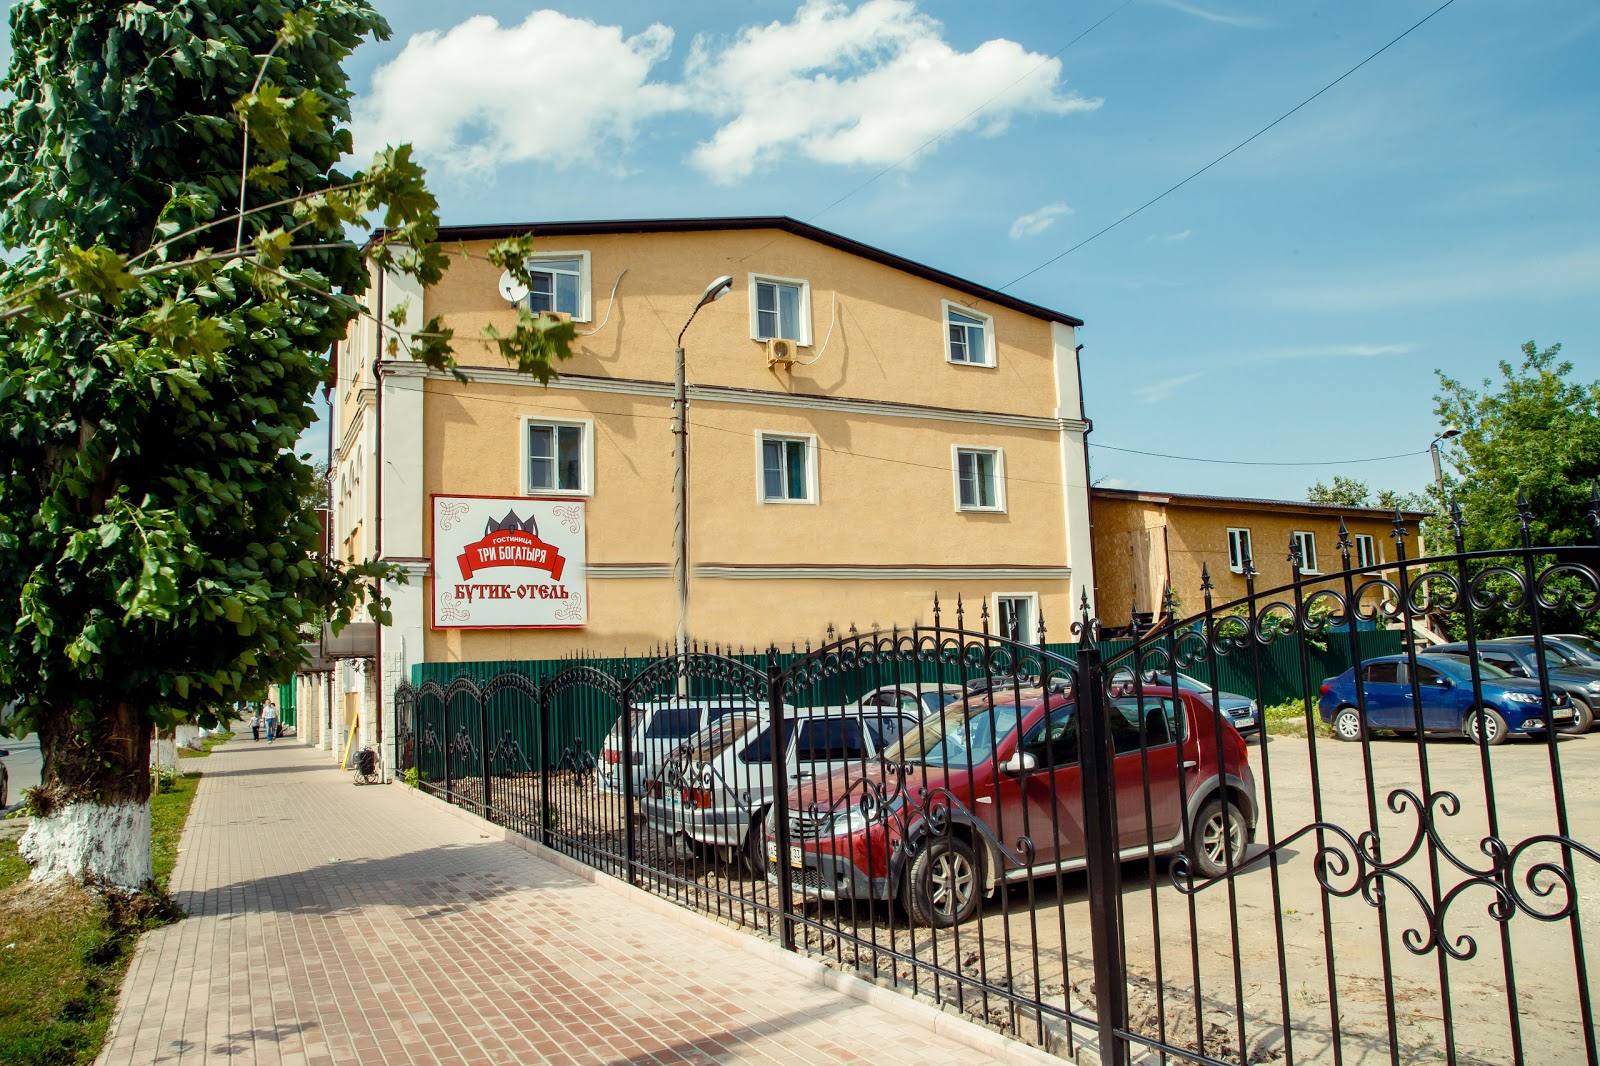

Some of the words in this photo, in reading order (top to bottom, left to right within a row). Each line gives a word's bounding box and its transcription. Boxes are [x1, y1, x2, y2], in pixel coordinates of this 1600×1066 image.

[492, 536, 532, 545] ГОСТИНИЦА
[477, 546, 497, 562] ТРИ
[499, 545, 547, 563] БОГАТЫРЯ
[454, 584, 569, 604] БУТИК-ОТЕЛЬ
